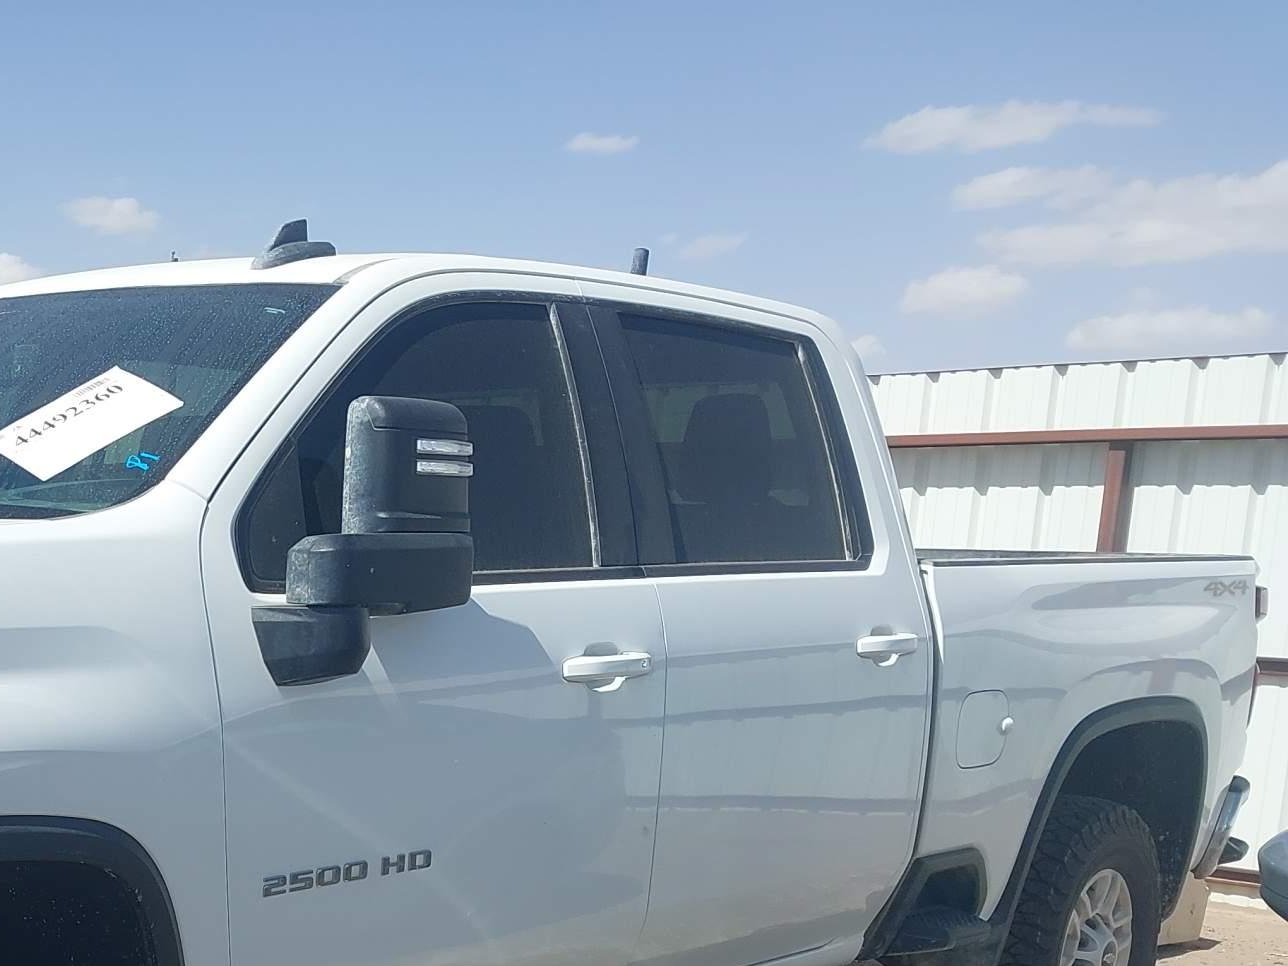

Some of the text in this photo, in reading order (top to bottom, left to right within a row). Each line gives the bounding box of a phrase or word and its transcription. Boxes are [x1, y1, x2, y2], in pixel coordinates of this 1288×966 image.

[15, 384, 124, 446] 44492360
[262, 849, 432, 898] 2500 HD
